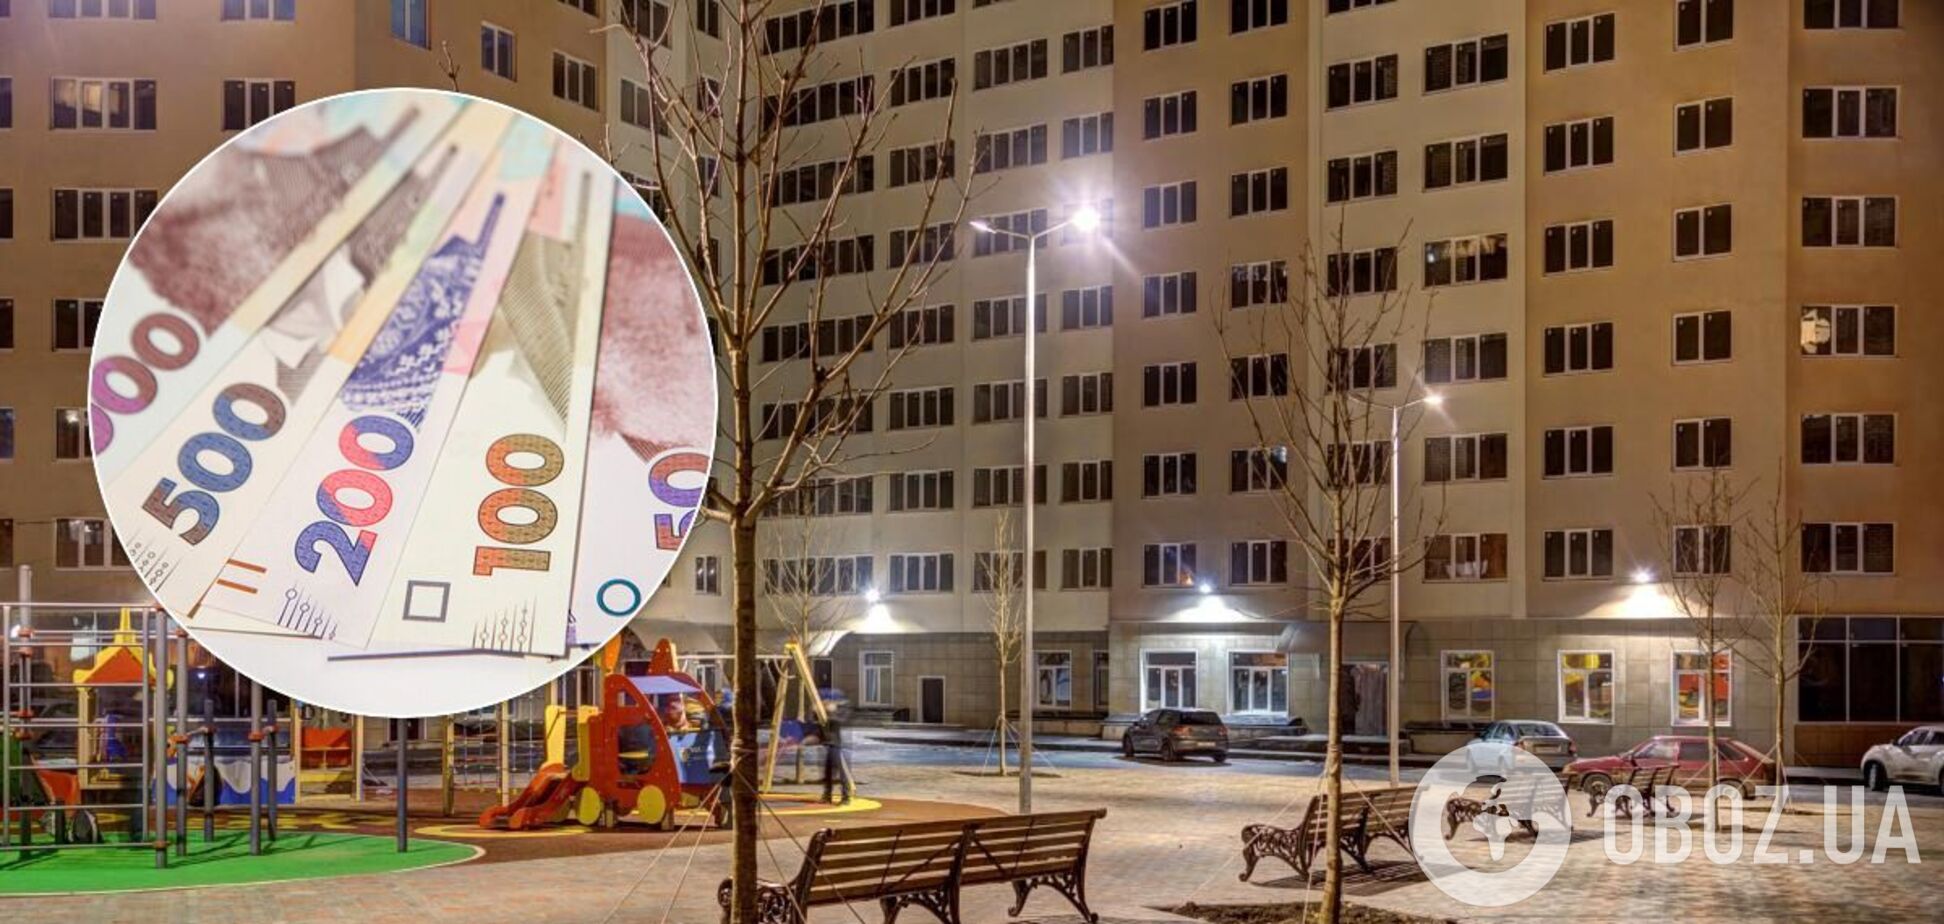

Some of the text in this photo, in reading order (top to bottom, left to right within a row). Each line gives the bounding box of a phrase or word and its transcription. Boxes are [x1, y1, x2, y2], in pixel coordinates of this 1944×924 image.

[90, 313, 200, 455] 00
[142, 382, 286, 545] 500
[295, 415, 414, 586] 200
[473, 433, 565, 576] 100
